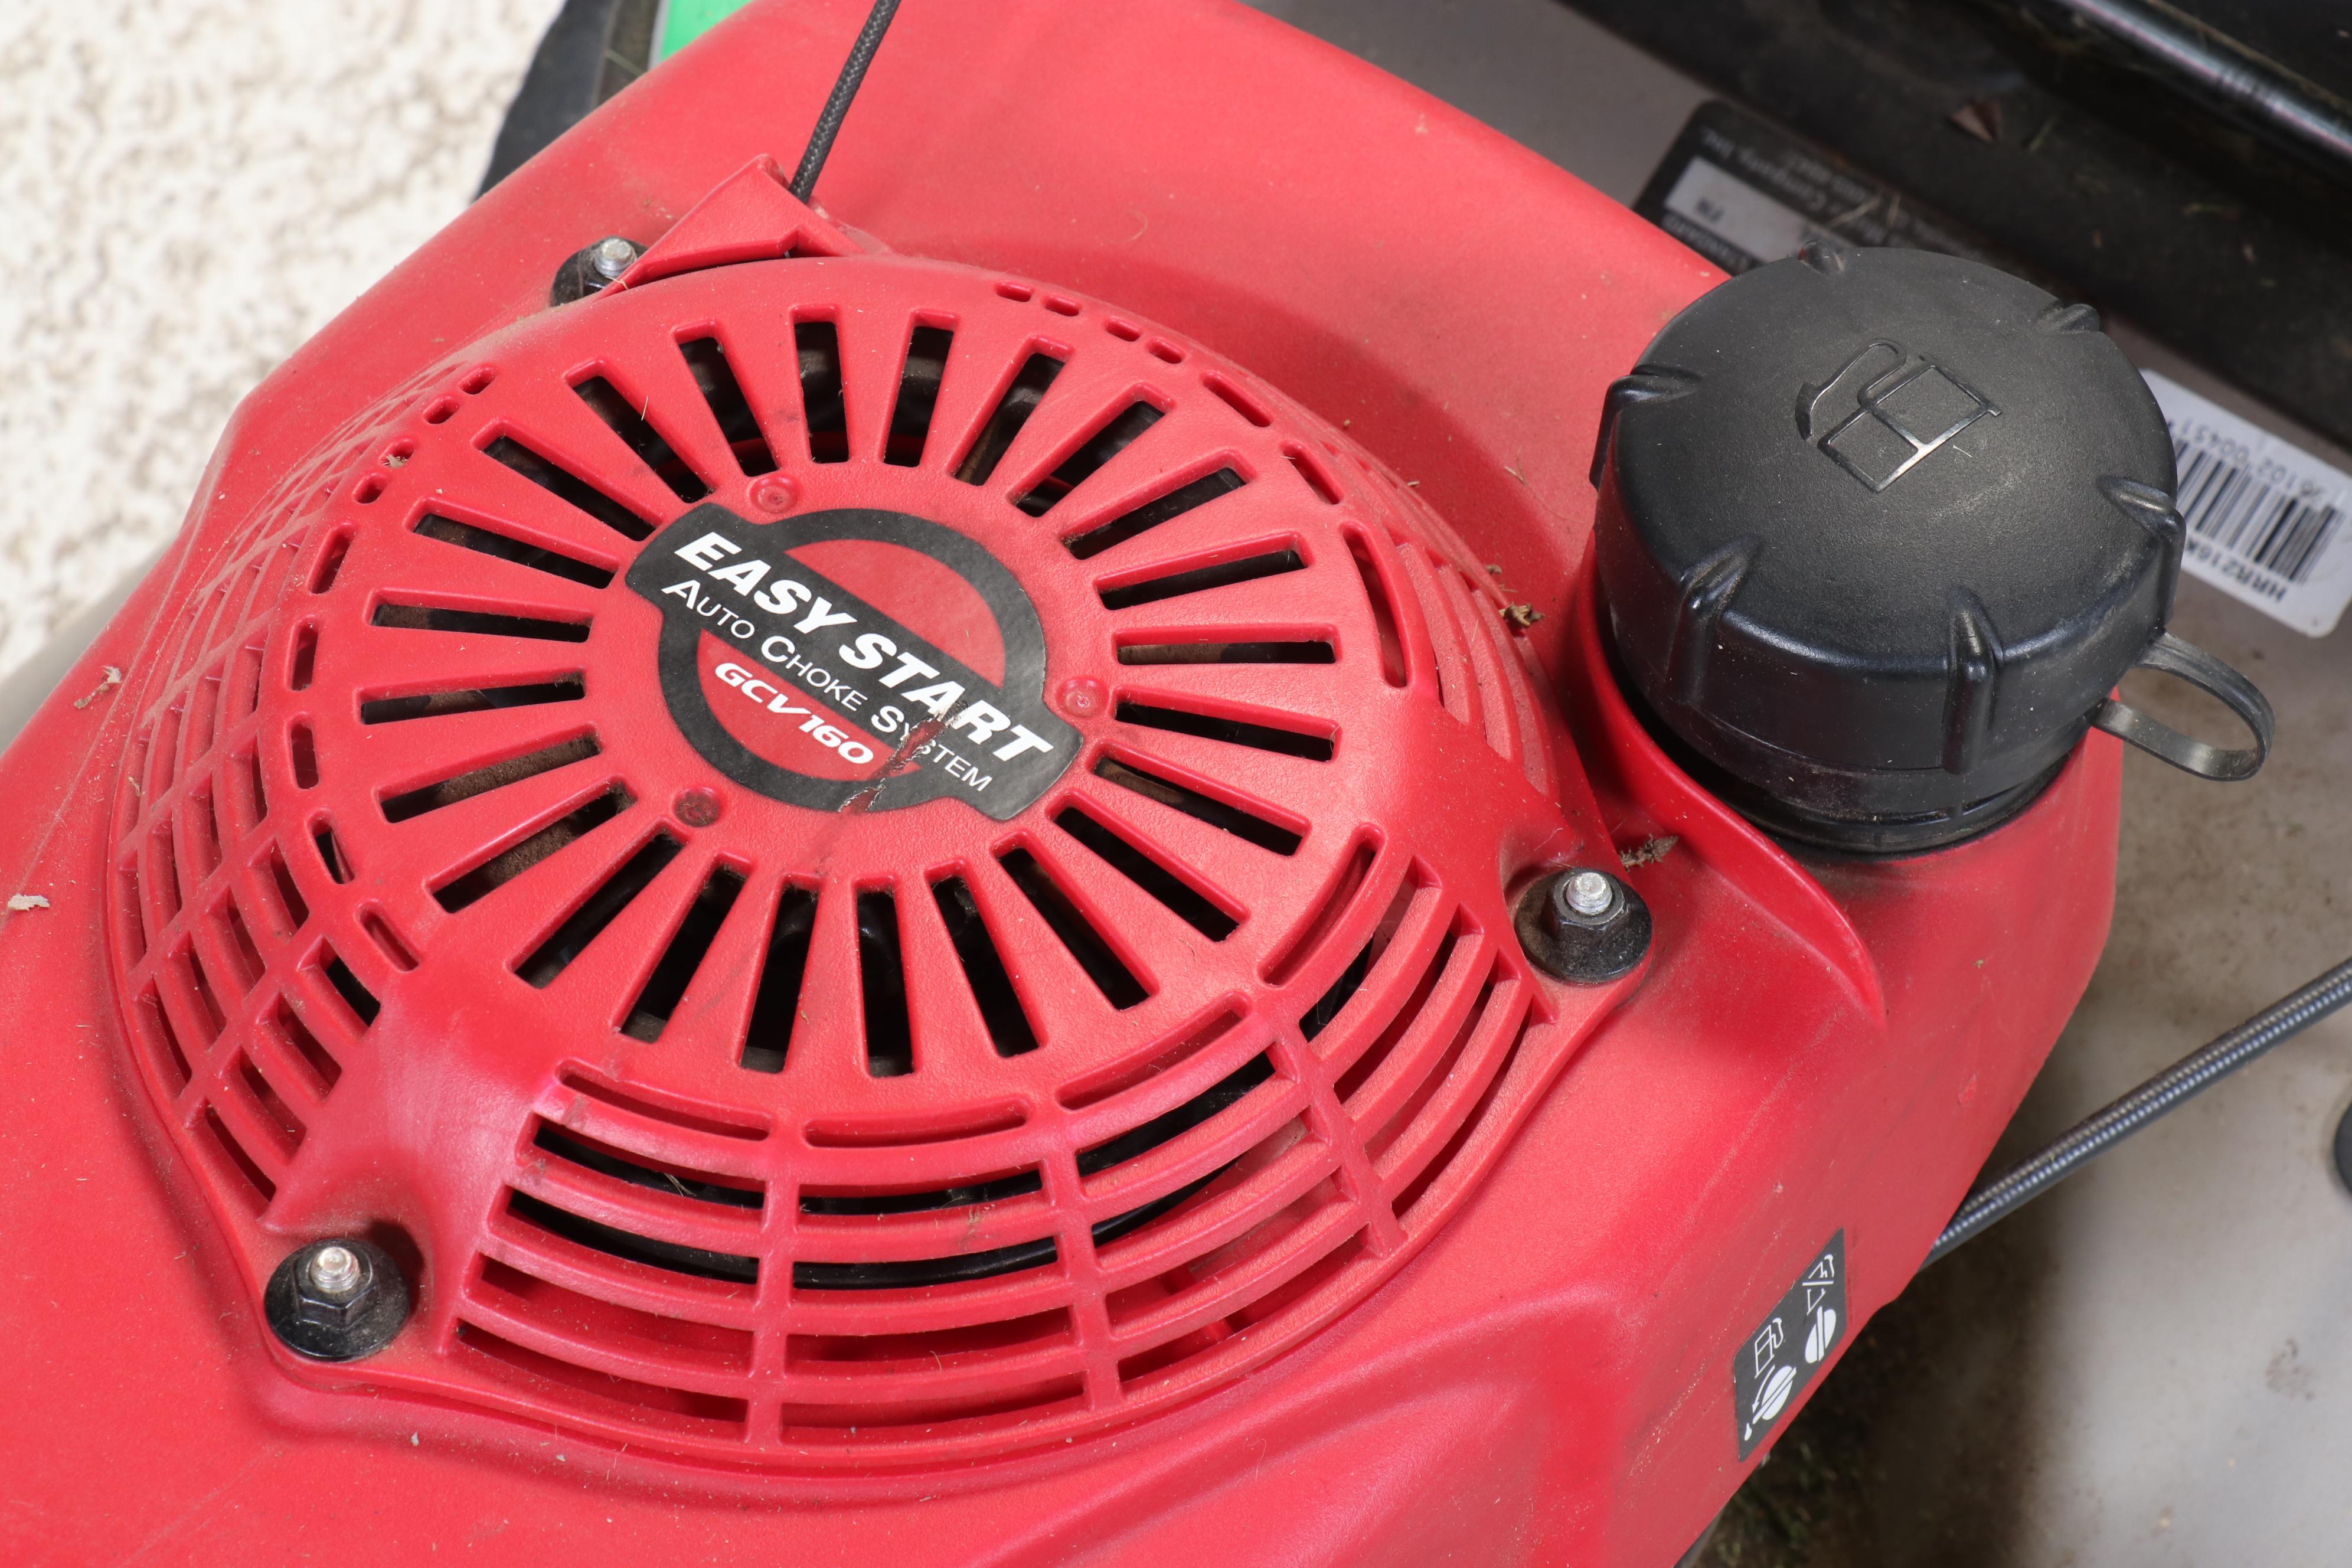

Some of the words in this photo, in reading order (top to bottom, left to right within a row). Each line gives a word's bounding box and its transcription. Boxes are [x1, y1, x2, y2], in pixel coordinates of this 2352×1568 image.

[662, 579, 756, 639] AUTO
[761, 635, 868, 713] CHOKE
[674, 531, 857, 635] EASY
[838, 632, 1054, 763] START
[714, 662, 875, 764] GCV160
